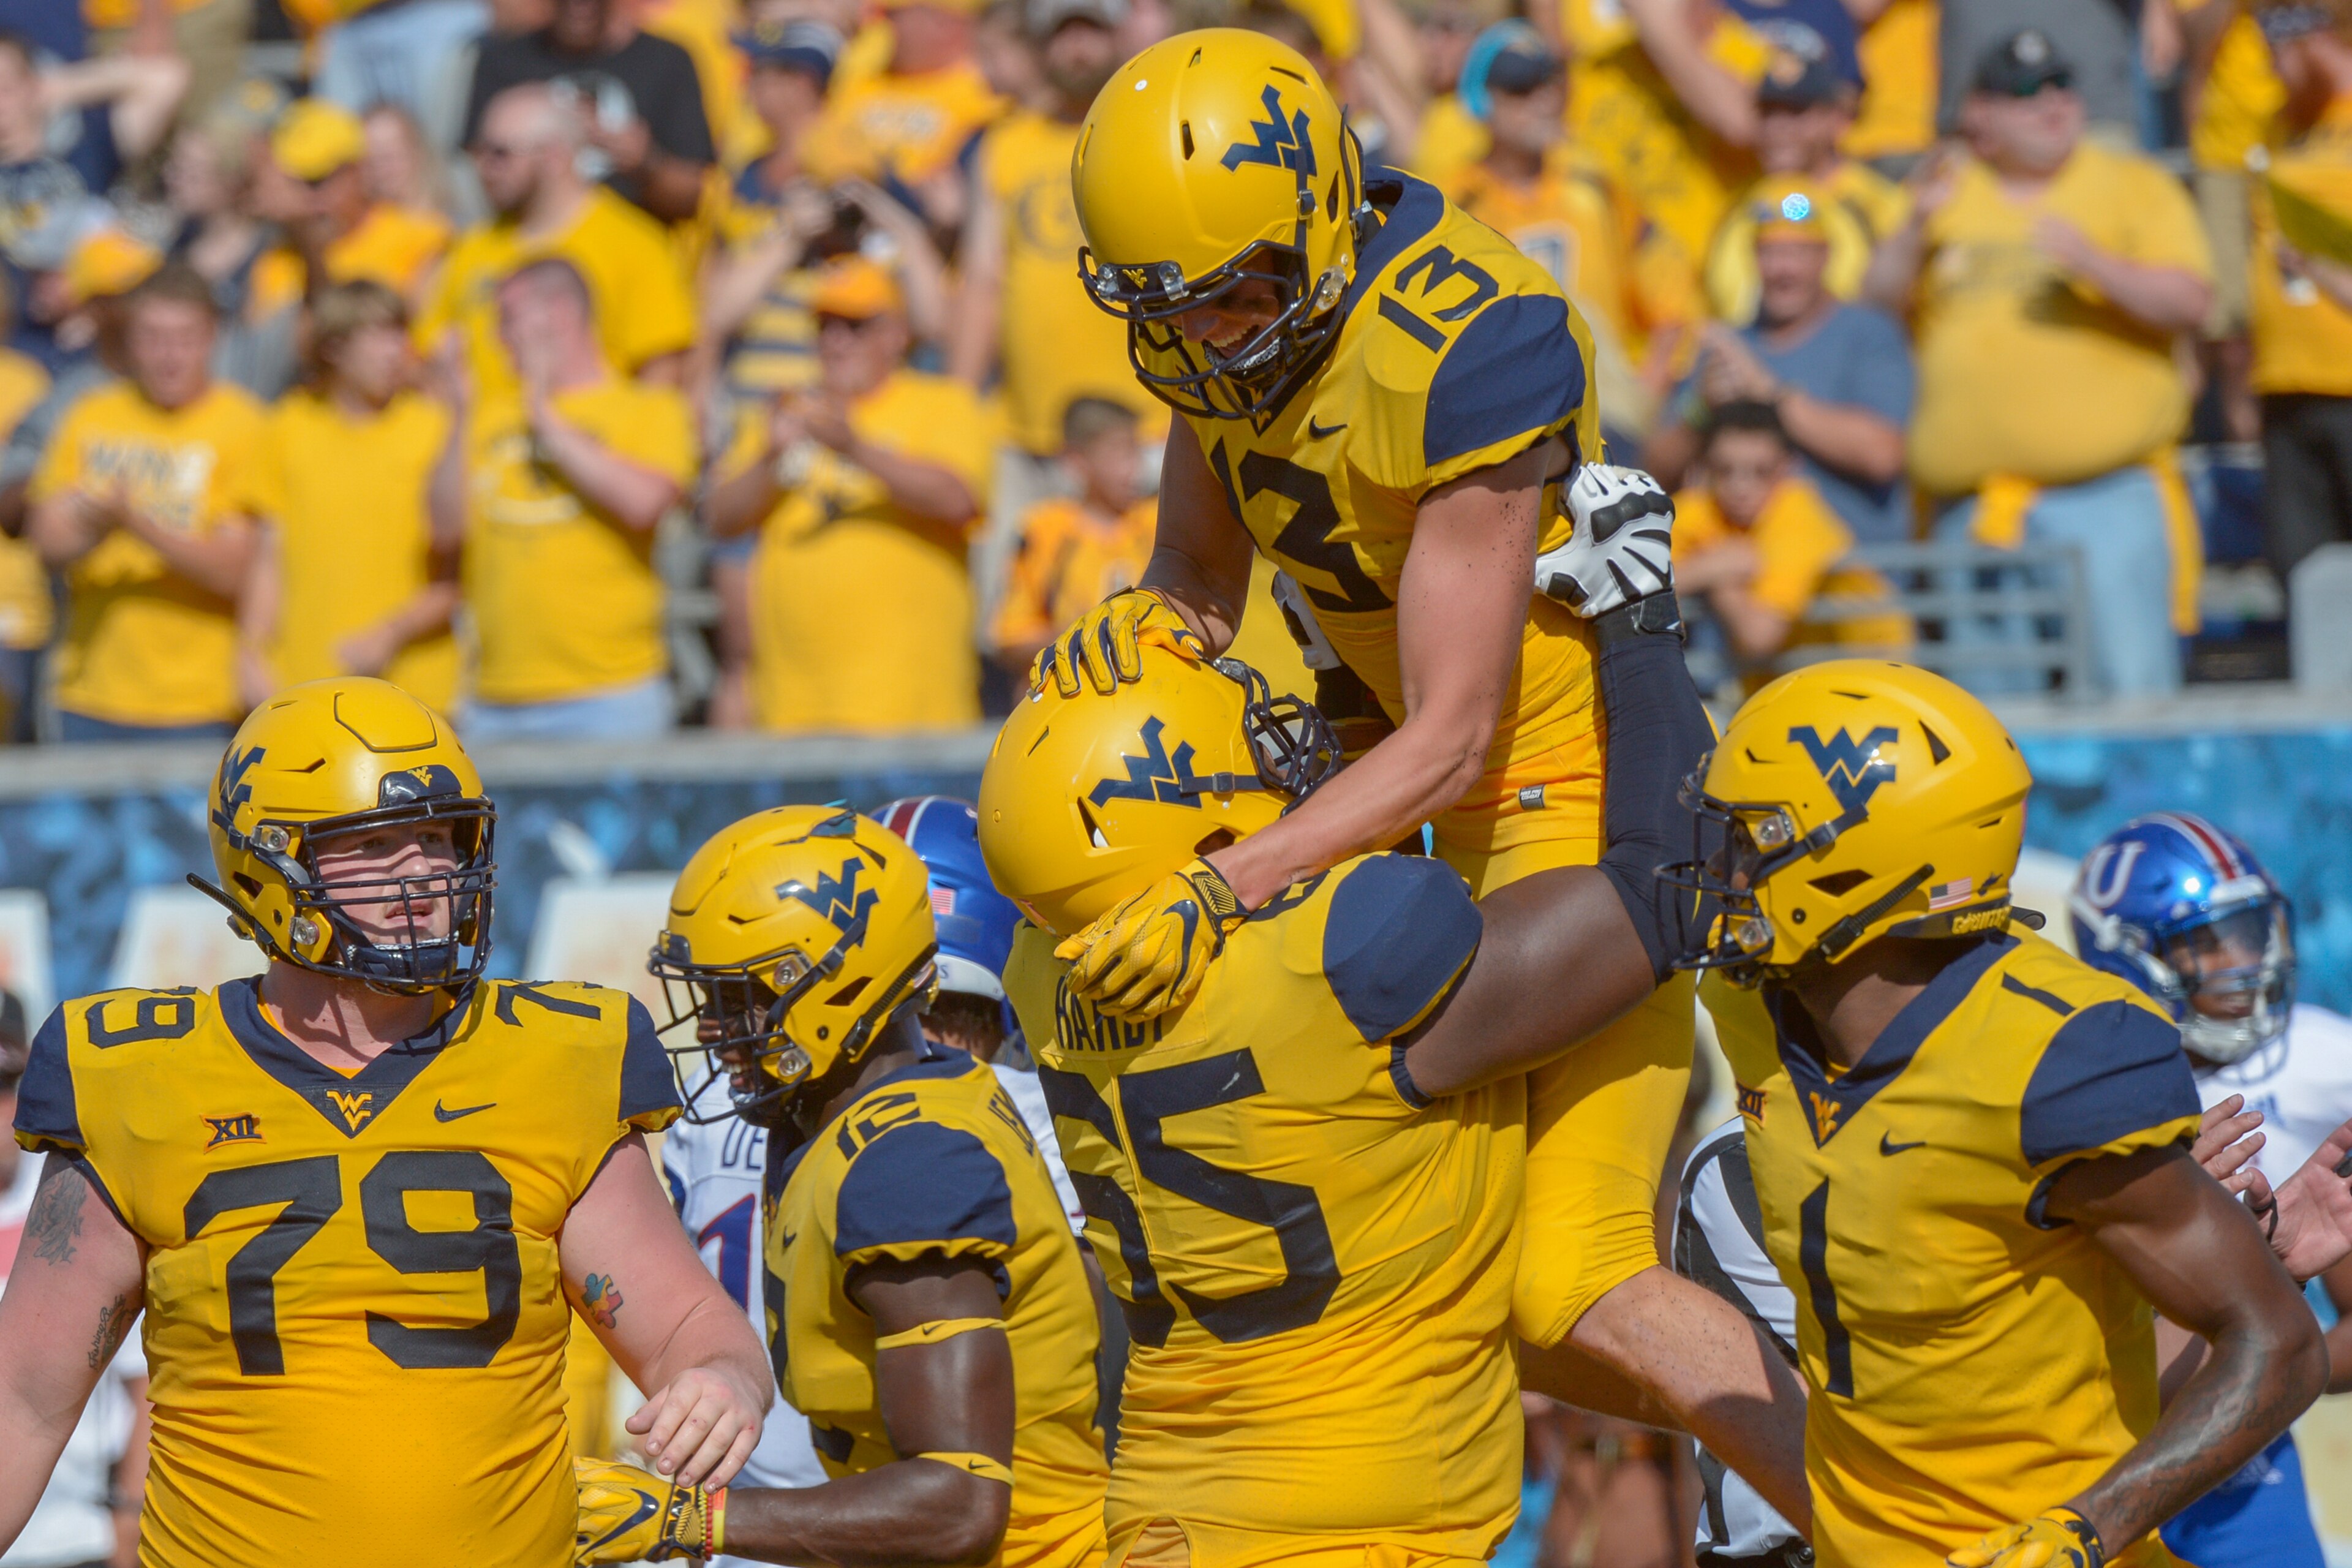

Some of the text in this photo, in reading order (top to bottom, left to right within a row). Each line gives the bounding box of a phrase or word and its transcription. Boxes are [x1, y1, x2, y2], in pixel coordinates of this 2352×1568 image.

[1378, 244, 1499, 353] 13
[2002, 972, 2076, 1016] 1
[837, 1092, 921, 1162] 12
[184, 1151, 521, 1376] 79
[1800, 1175, 1854, 1399] 1
